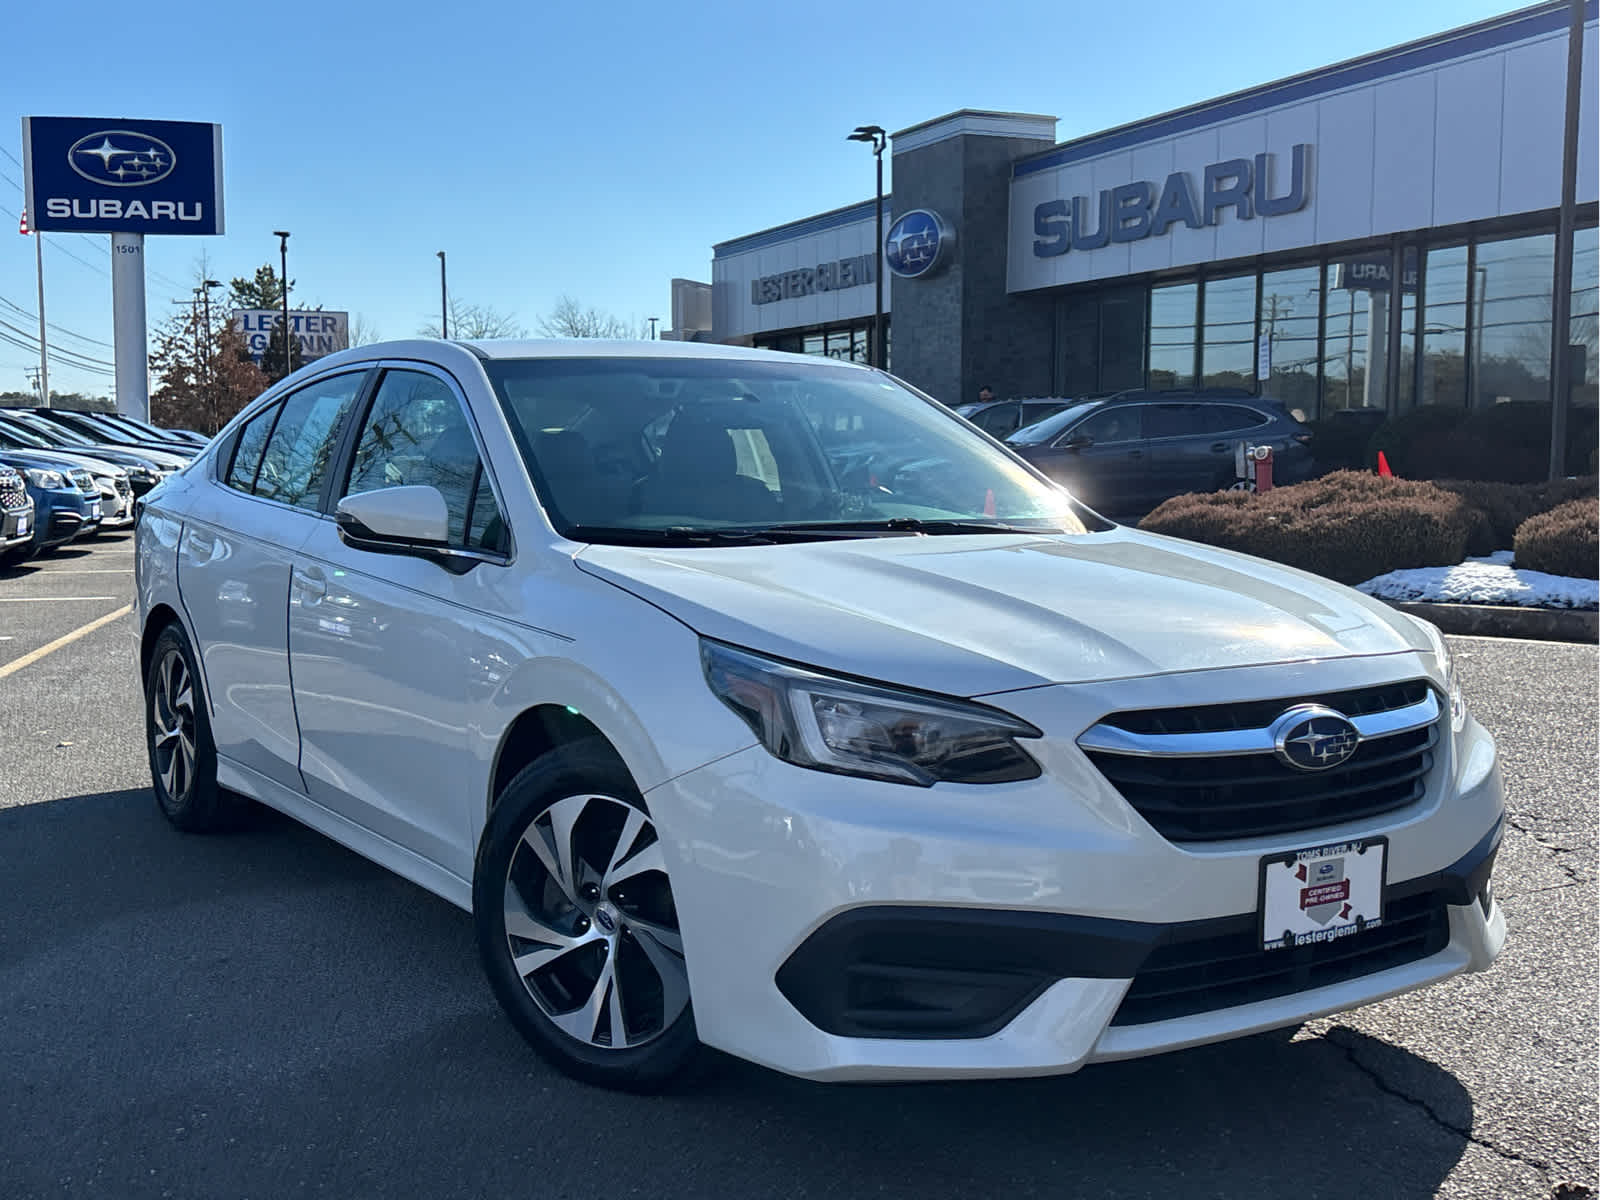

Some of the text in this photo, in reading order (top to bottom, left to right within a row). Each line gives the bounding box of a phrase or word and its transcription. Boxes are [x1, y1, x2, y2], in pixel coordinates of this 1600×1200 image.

[46, 197, 202, 221] SUBARU
[1033, 143, 1311, 258] SUBARU
[115, 245, 140, 255] 1501
[751, 267, 816, 305] LESTER
[250, 334, 333, 353] GNN
[1297, 848, 1321, 861] TOMS
[1307, 885, 1343, 897] CERTIFIED
[1294, 924, 1358, 946] lesterglenn
